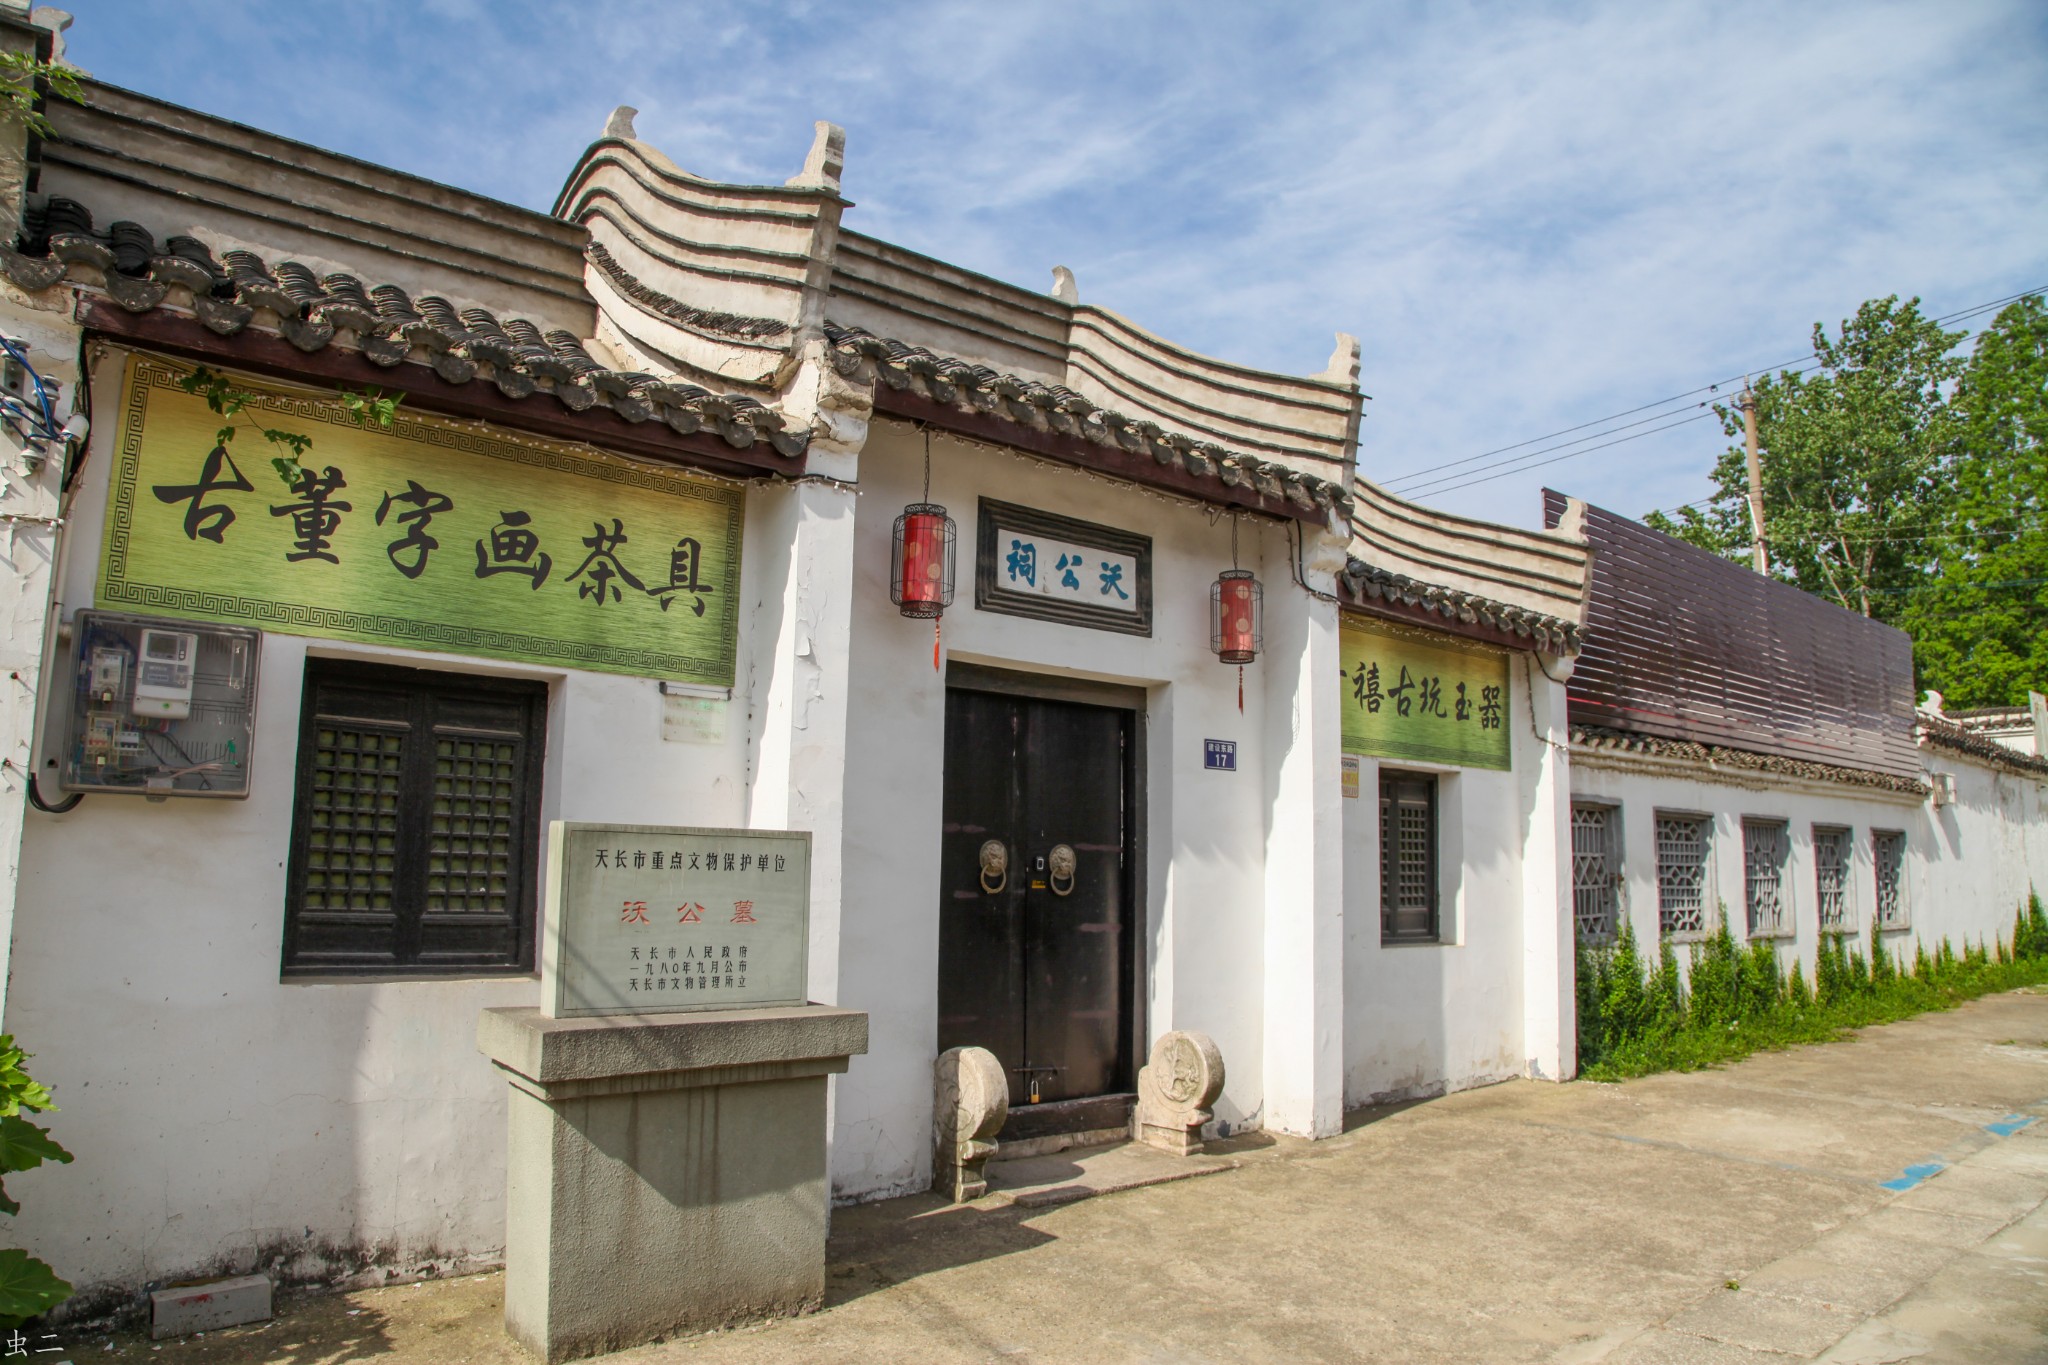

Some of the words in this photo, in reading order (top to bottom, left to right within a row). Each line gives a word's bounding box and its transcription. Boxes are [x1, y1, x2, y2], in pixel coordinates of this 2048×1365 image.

[152, 445, 714, 617] 古董字画茶具
[1340, 661, 1501, 730] 禧古玩玉器
[1215, 754, 1227, 767] 17
[595, 849, 786, 872] 天长市重点文物保护单位
[621, 900, 758, 925] 沃公墓
[630, 946, 748, 960] 天长市人民政府
[629, 975, 747, 991] 天长市文物管理所立
